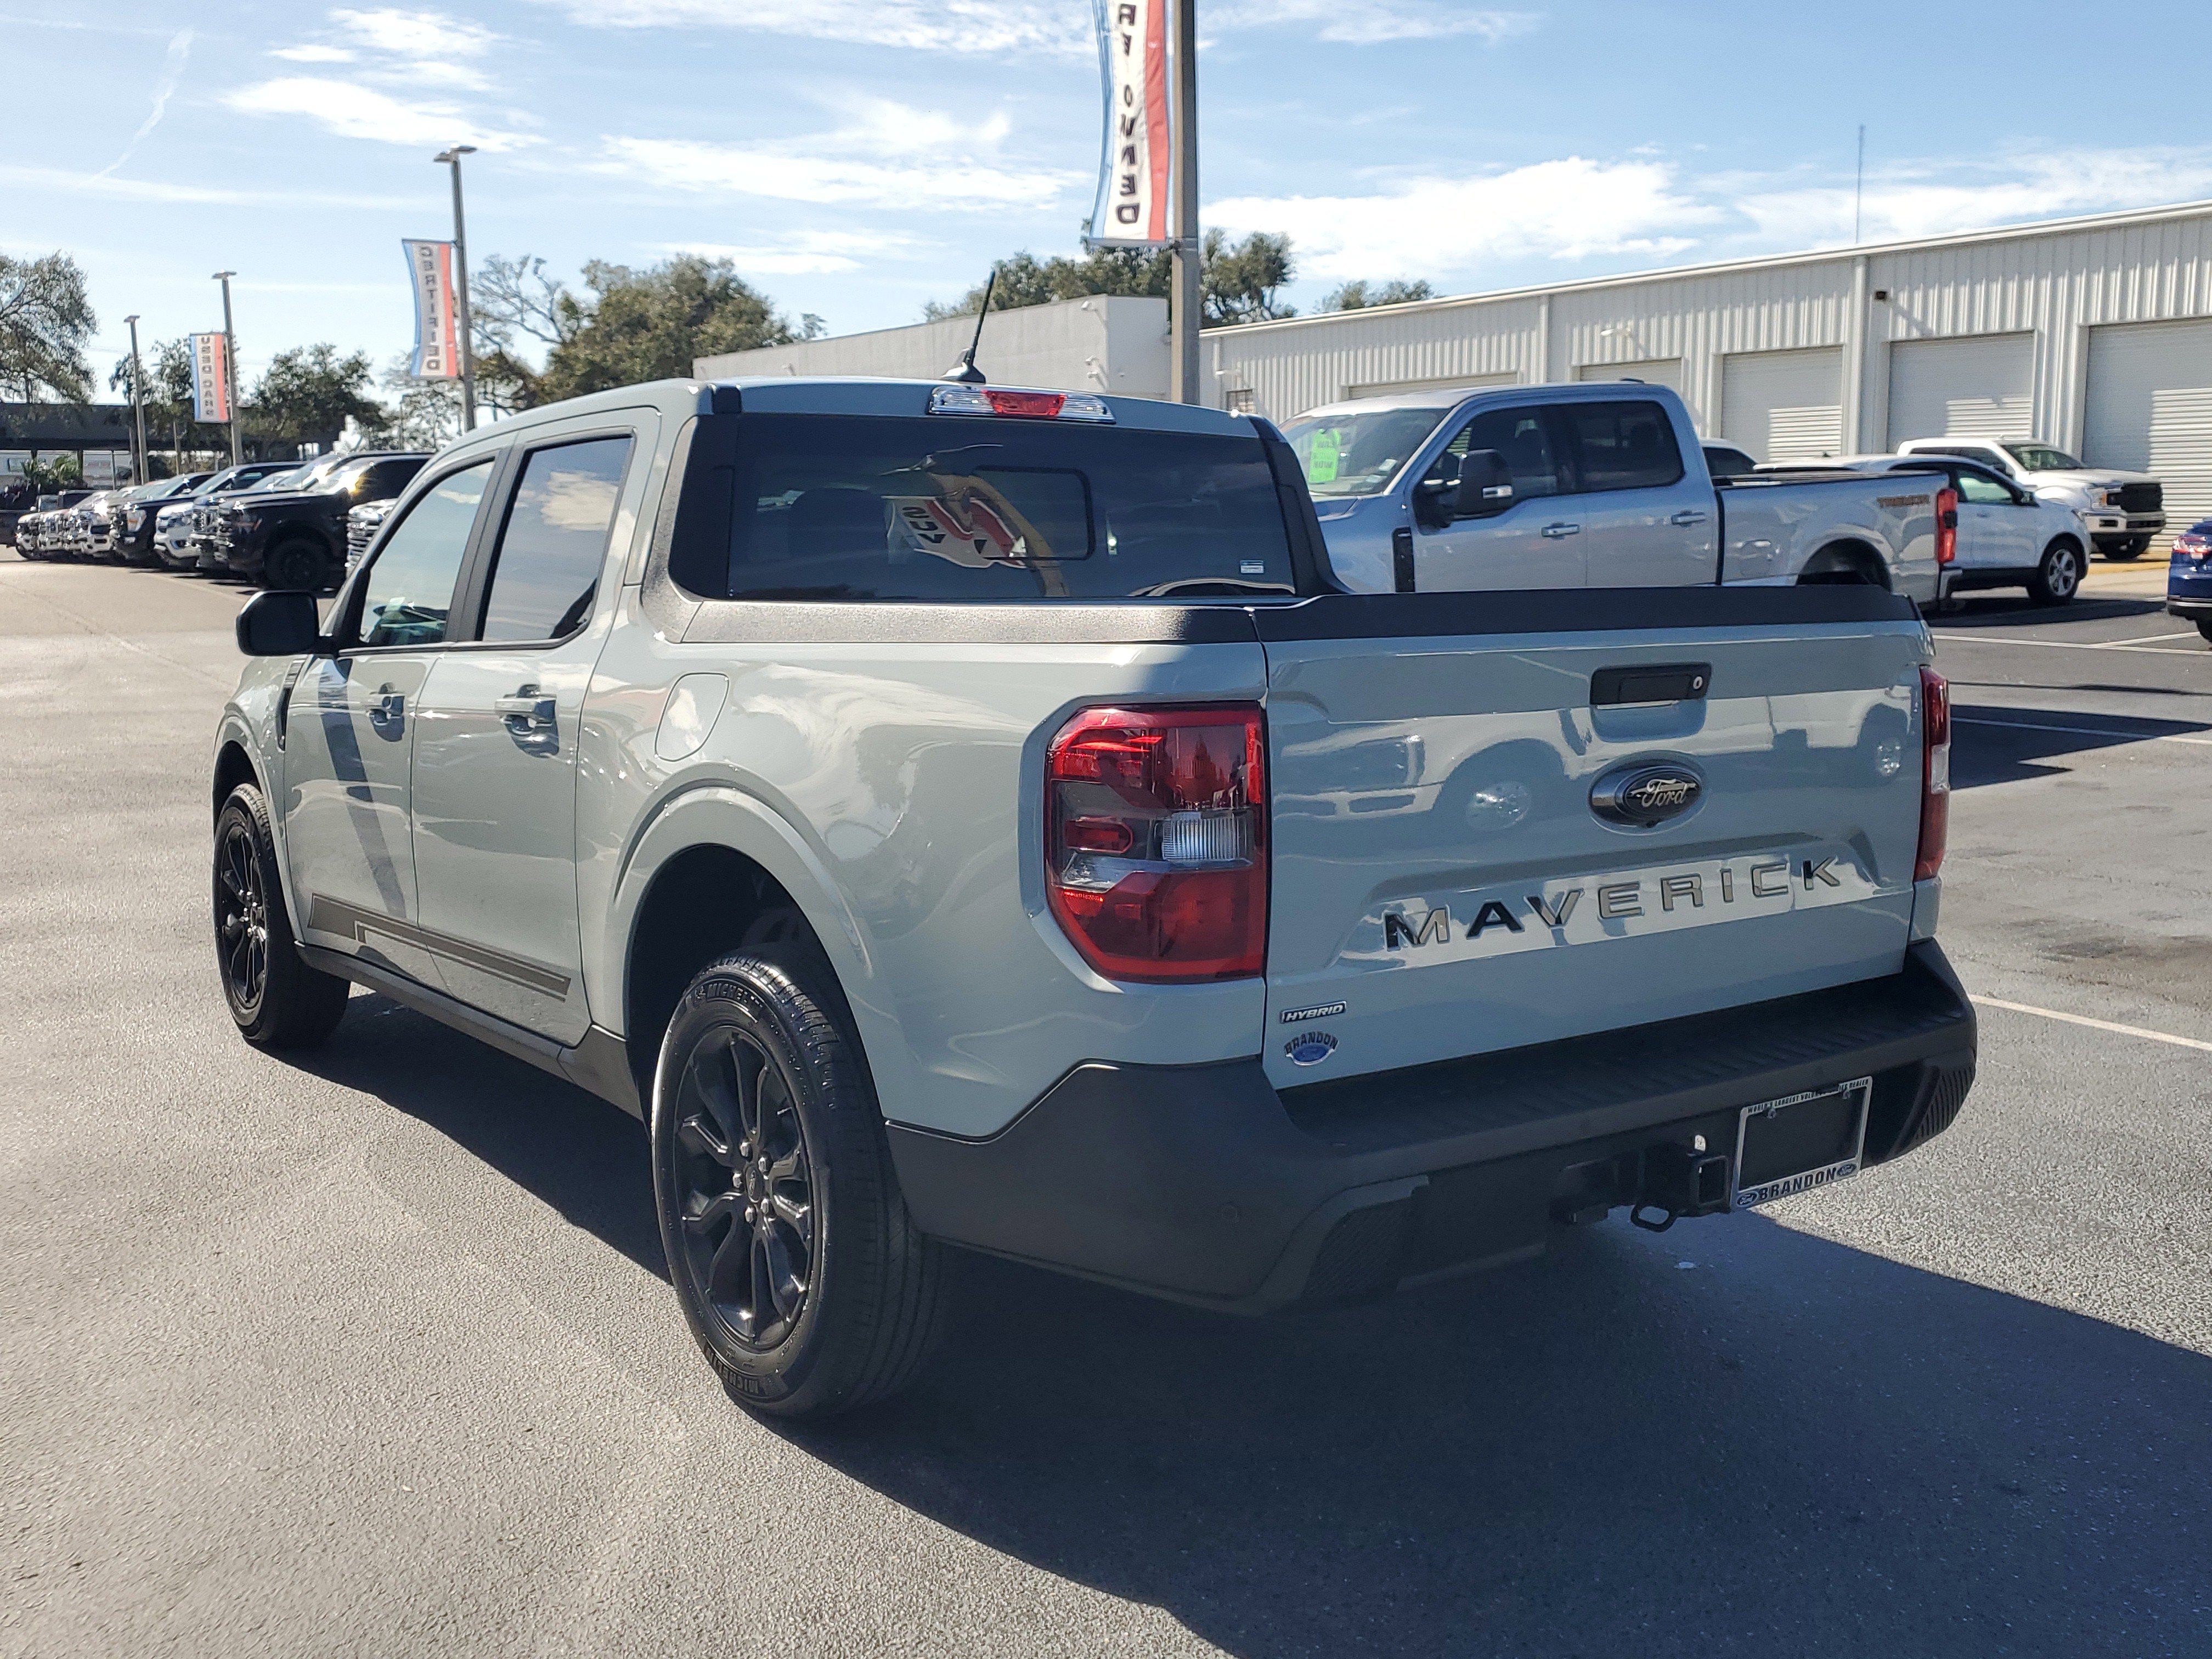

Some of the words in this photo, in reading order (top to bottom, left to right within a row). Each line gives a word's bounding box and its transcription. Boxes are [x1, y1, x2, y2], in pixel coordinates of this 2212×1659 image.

[1641, 778, 1689, 808] Ford
[1385, 856, 1841, 951] MAVERICK
[1285, 1005, 1344, 1021] HYBRID
[1284, 1031, 1339, 1054] BRANDON
[1758, 1167, 1837, 1200] BRANDON
